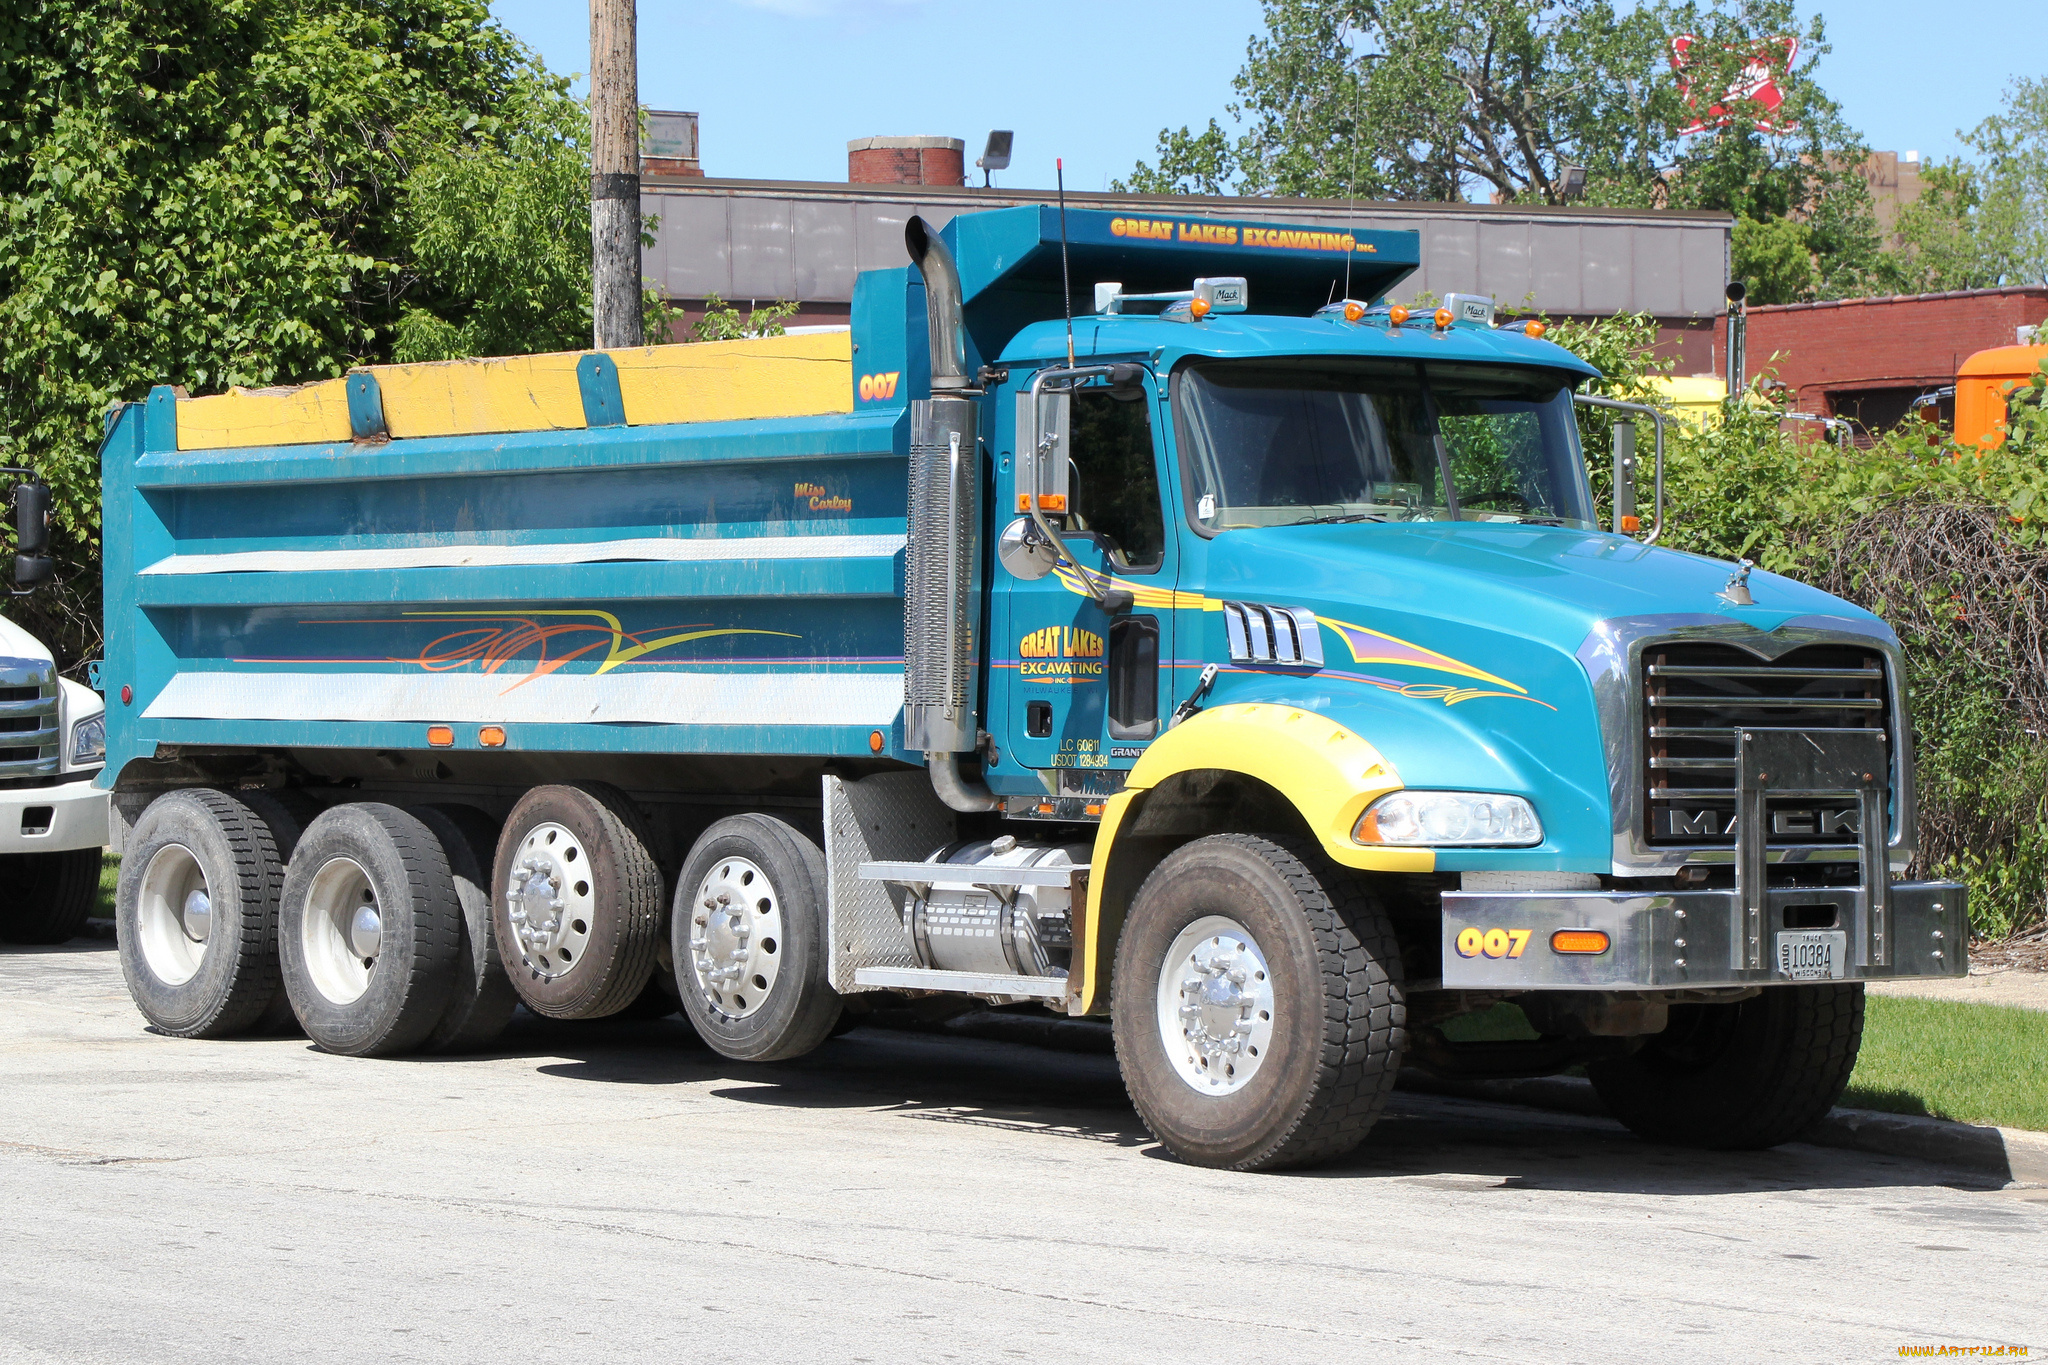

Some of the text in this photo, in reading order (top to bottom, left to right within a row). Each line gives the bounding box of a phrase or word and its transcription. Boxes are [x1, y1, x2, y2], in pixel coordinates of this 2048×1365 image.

[1110, 217, 1377, 253] GREAT LAKES EXCAVATING INC.
[1215, 290, 1238, 300] Mack
[1465, 305, 1486, 317] Mack
[858, 371, 900, 402] 007
[794, 482, 826, 497] Miss
[808, 495, 852, 513] Carley
[1019, 625, 1104, 658] GREAT LAKES
[1020, 661, 1102, 675] EXCAVATING
[1060, 738, 1100, 752] LC 60811
[1110, 747, 1145, 757] GRANIT
[1050, 754, 1109, 767] USDOT 1284934
[1669, 810, 1860, 835] MCK
[1454, 927, 1533, 959] 007
[1792, 943, 1831, 968] 10384
